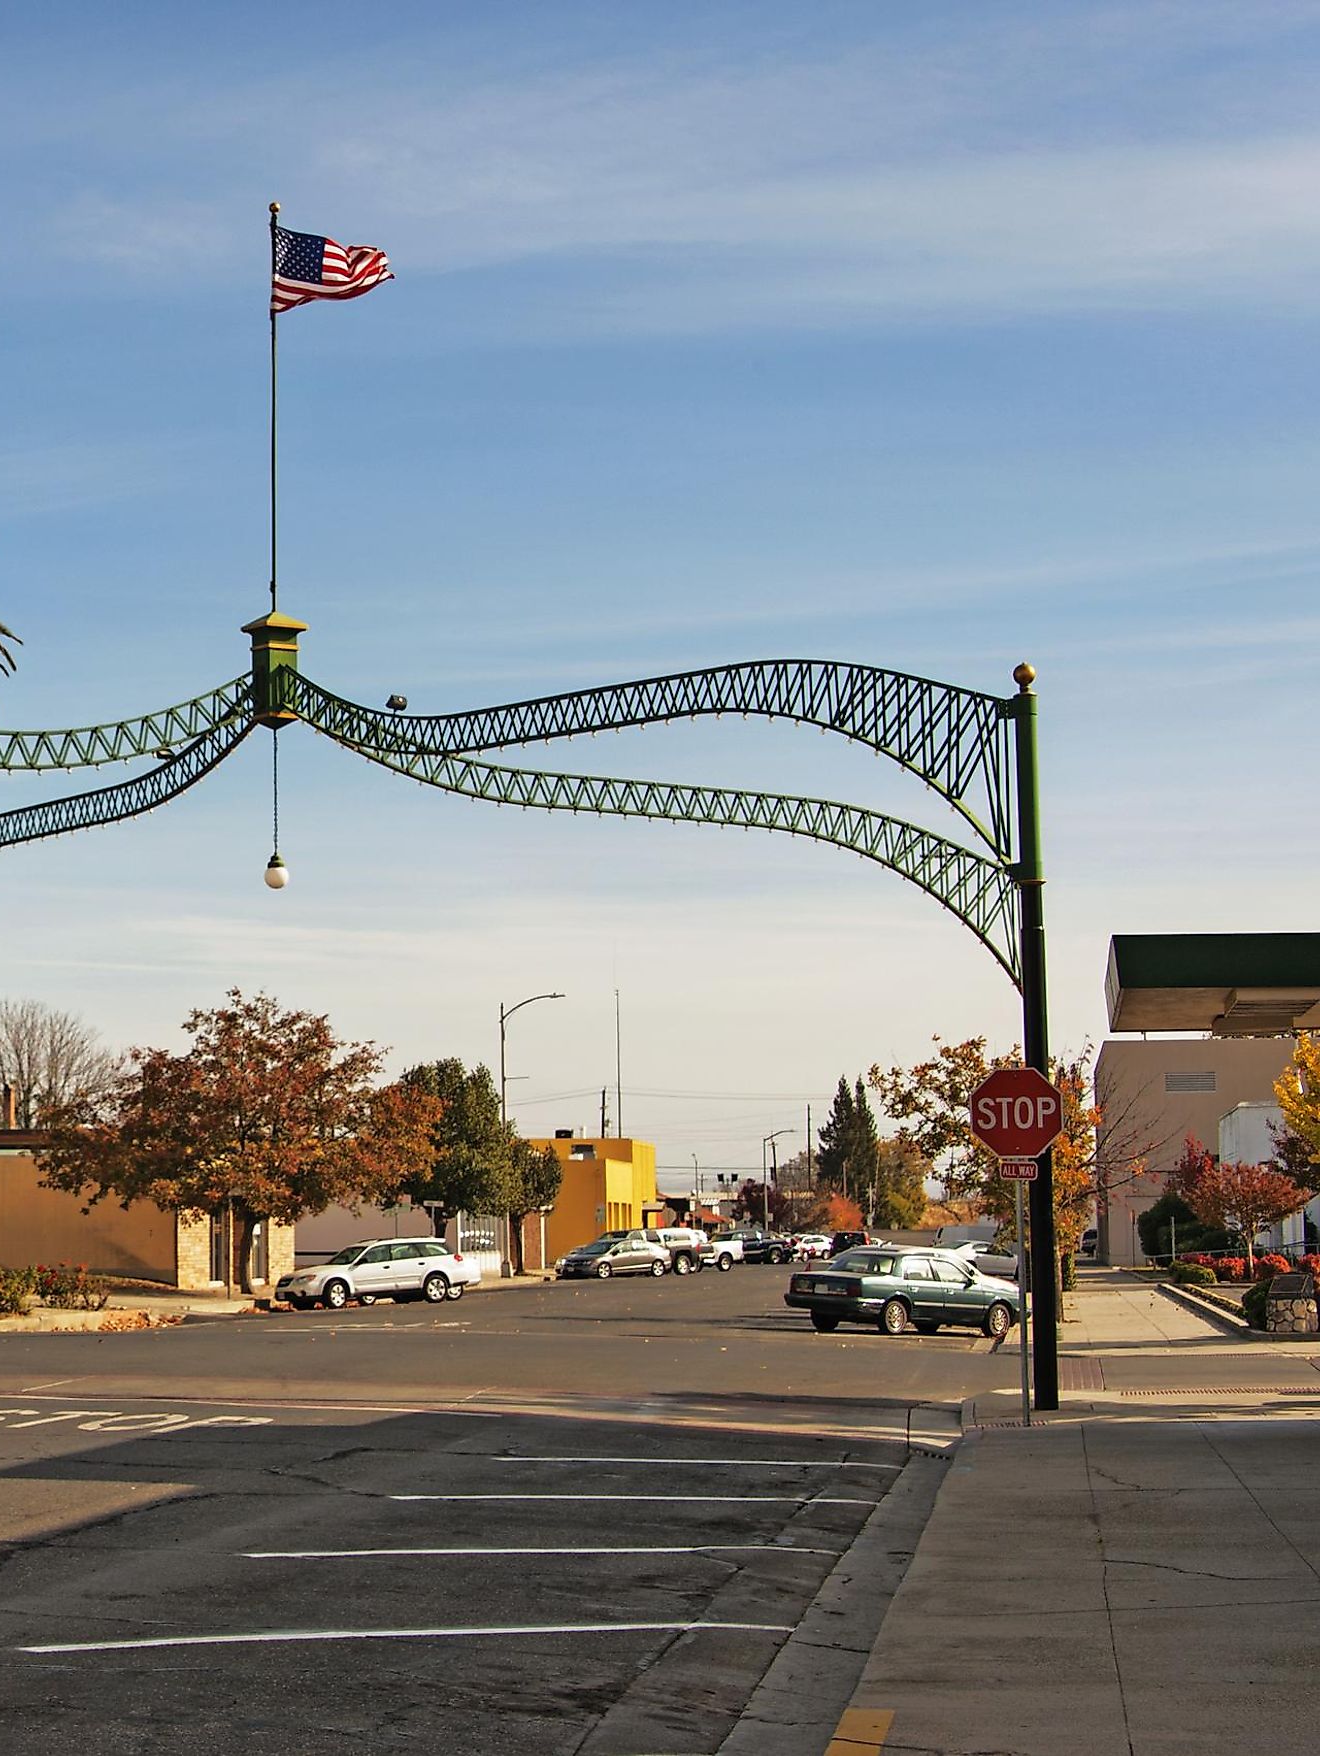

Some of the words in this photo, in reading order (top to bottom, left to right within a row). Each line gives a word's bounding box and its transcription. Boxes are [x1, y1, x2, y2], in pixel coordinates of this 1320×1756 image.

[977, 1096, 1056, 1130] STOP
[1002, 1165, 1017, 1176] ALL
[1018, 1165, 1036, 1176] WAY
